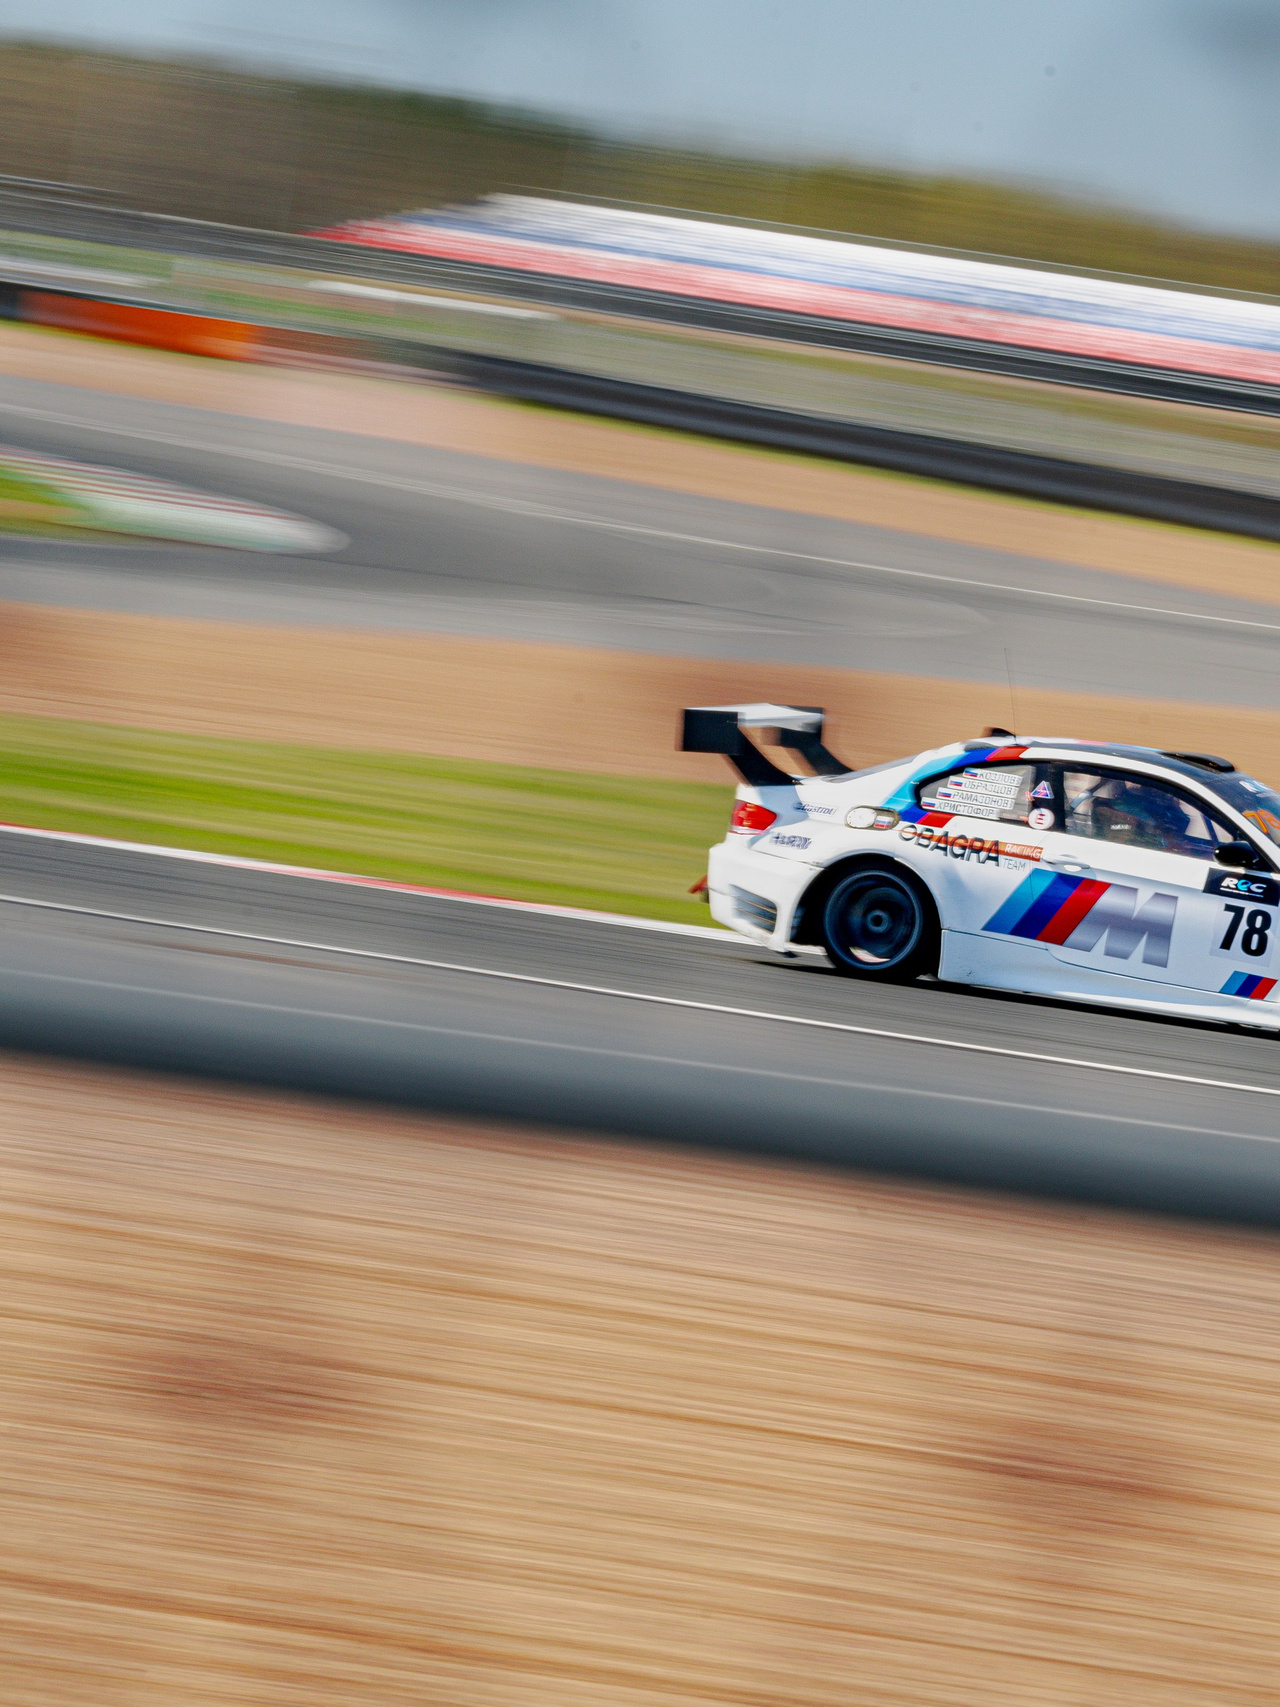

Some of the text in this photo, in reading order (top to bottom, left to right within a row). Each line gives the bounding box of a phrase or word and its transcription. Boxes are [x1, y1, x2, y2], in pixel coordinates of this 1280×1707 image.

[801, 802, 835, 815] Castrol
[936, 801, 994, 817] ХРИСТОФОР
[1005, 844, 1043, 859] RACING
[1003, 858, 1026, 872] TEAM
[1219, 903, 1272, 957] 78
